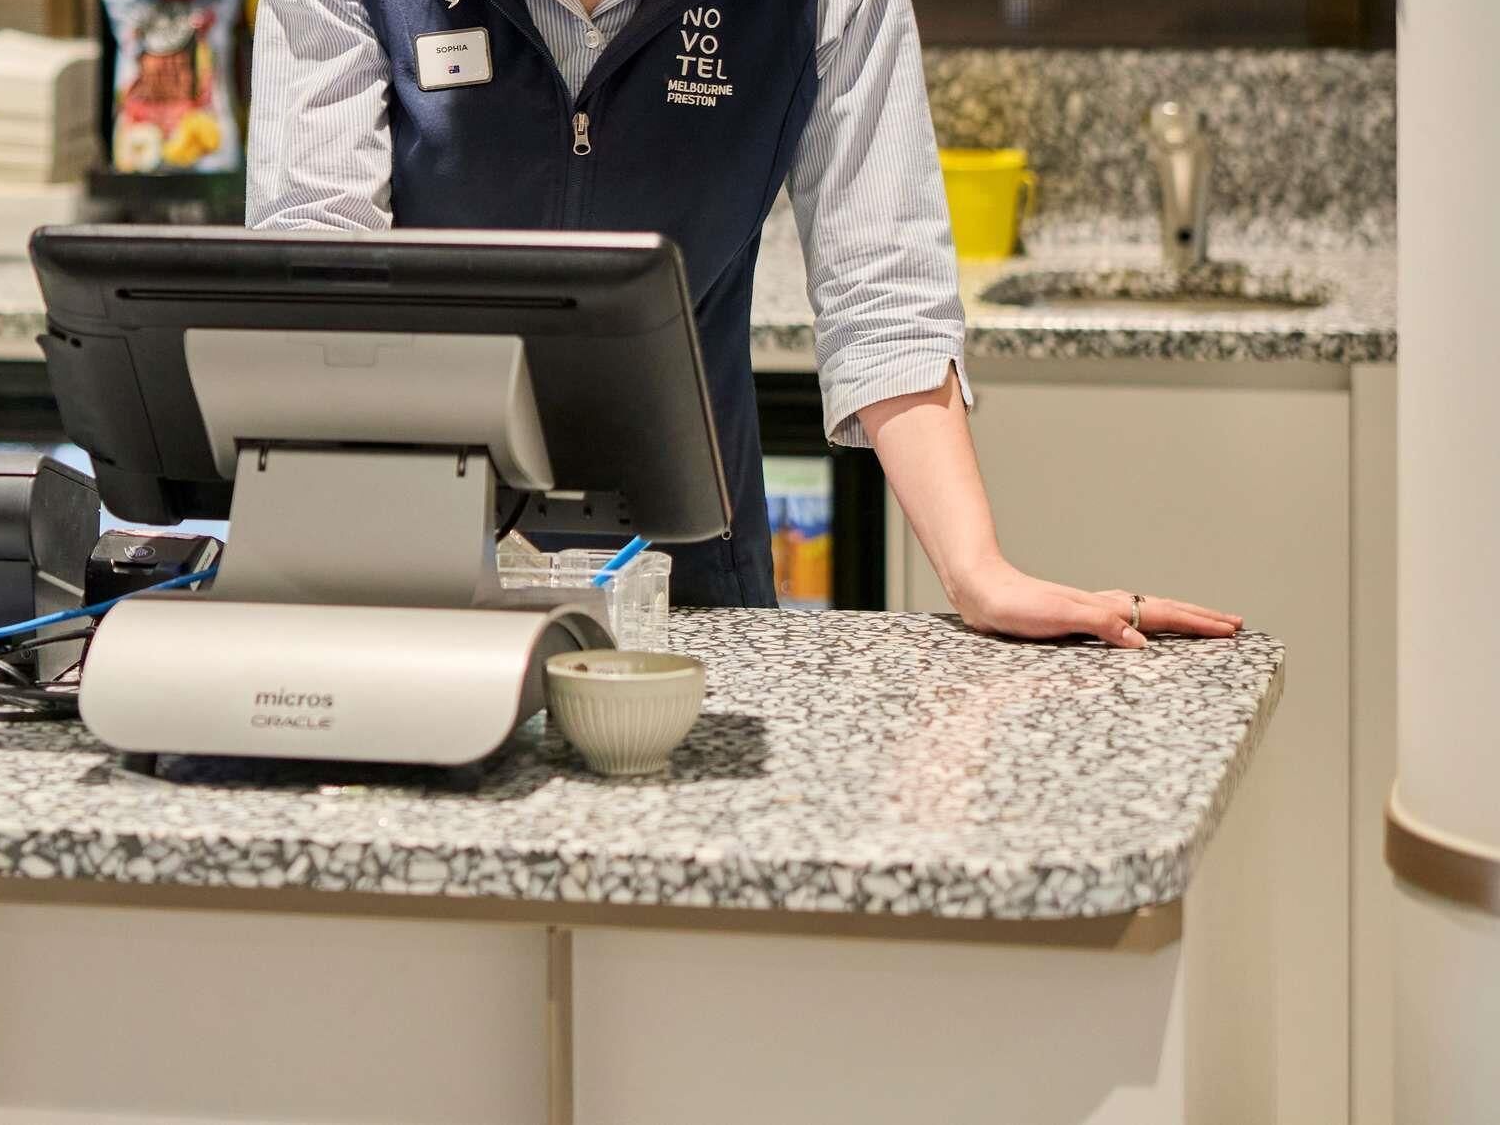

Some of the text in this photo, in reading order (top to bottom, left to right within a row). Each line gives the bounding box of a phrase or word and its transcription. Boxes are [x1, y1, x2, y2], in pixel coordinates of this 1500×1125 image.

[435, 44, 469, 54] SOPHIA
[667, 78, 733, 96] MELBOURNE
[666, 92, 717, 107] PRESTON
[253, 685, 333, 709] micros
[250, 714, 333, 730] ORACLE
